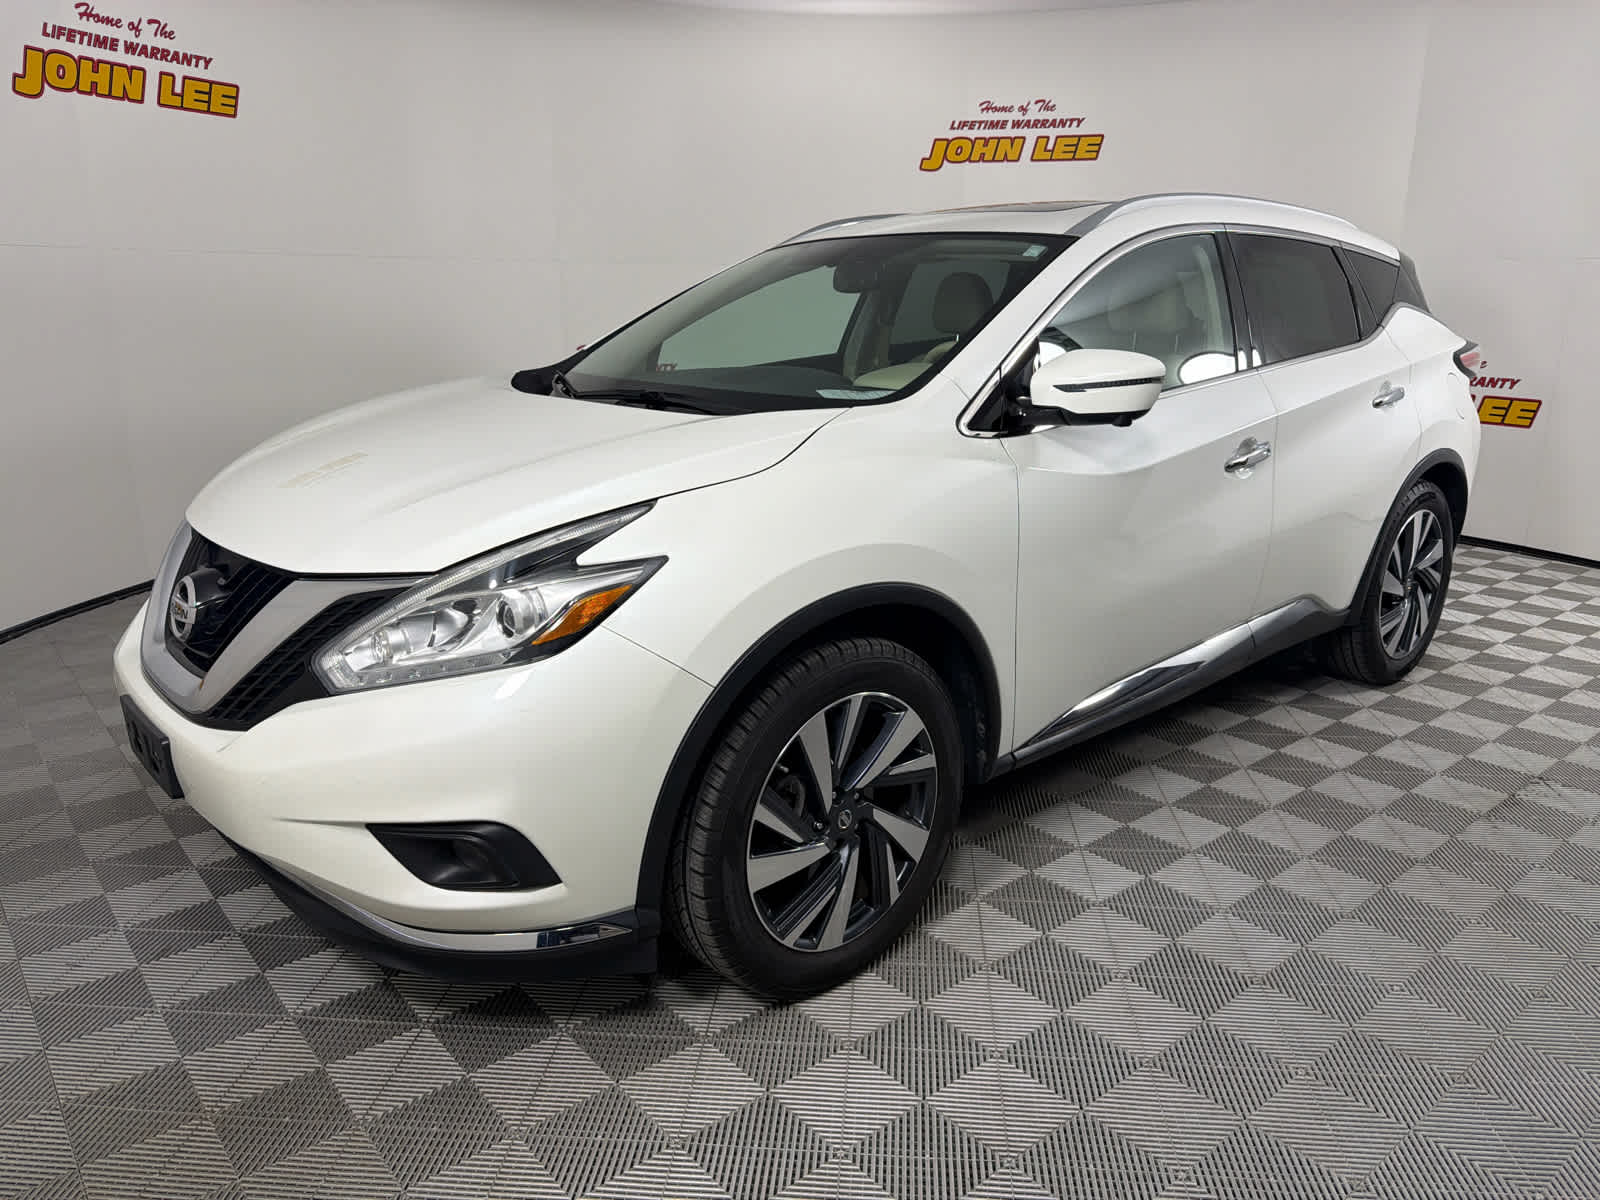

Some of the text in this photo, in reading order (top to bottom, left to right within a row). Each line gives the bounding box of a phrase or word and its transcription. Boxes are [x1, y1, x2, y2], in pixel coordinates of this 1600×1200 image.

[74, 2, 176, 40] Home of The
[41, 22, 213, 70] LIFETIME WARRANTY
[12, 44, 240, 119] JOHN LEE
[949, 117, 1086, 131] LIFETIME WARRANTY
[978, 99, 1057, 116] Home of The
[919, 134, 1105, 172] JOHN LEE
[1471, 394, 1542, 429] EE
